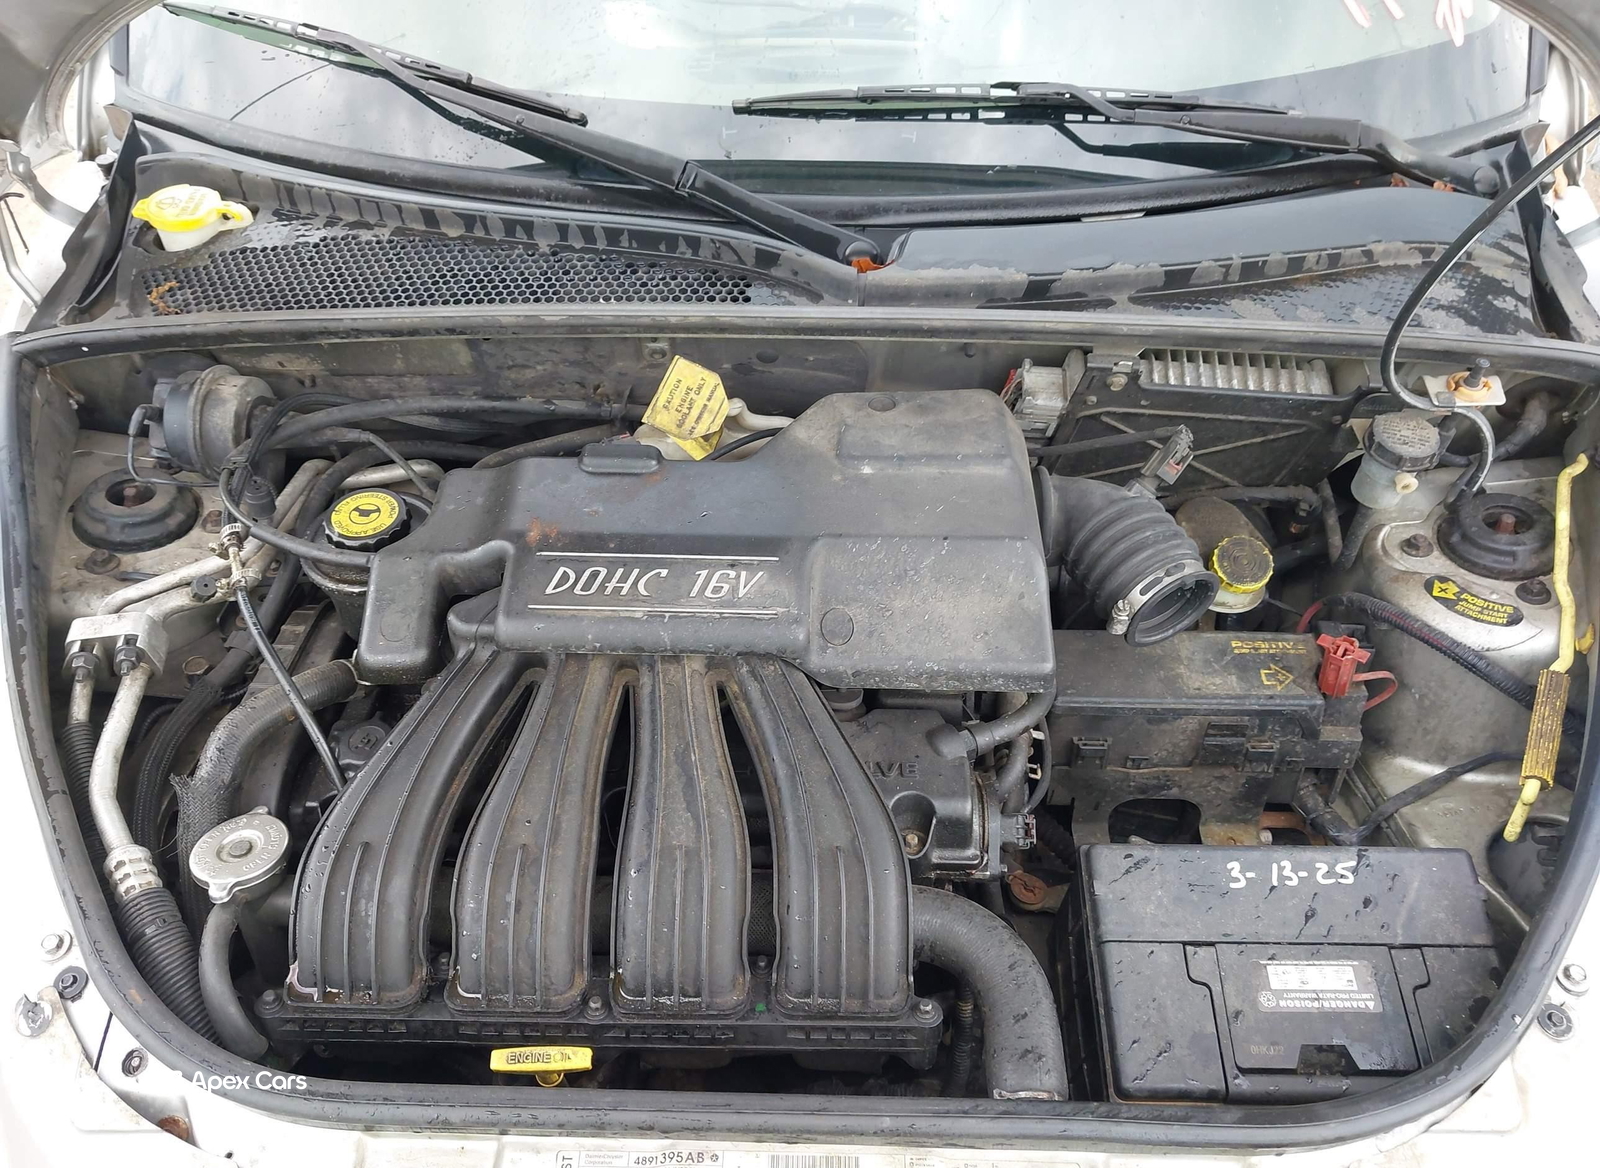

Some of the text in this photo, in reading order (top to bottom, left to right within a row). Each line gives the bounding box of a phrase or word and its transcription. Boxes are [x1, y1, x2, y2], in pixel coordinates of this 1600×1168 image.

[663, 378, 683, 411] CAUTION
[675, 385, 694, 414] ENGINE
[676, 376, 707, 429] COOLANT ONLY
[543, 566, 764, 599] DOHC 16V
[1458, 600, 1509, 619] JUMP START
[1459, 592, 1515, 614] POSITIVE
[1454, 604, 1509, 625] ATTACHMENT
[1279, 1000, 1366, 1009] DANGER/POISON
[506, 1051, 552, 1065] ENGINE
